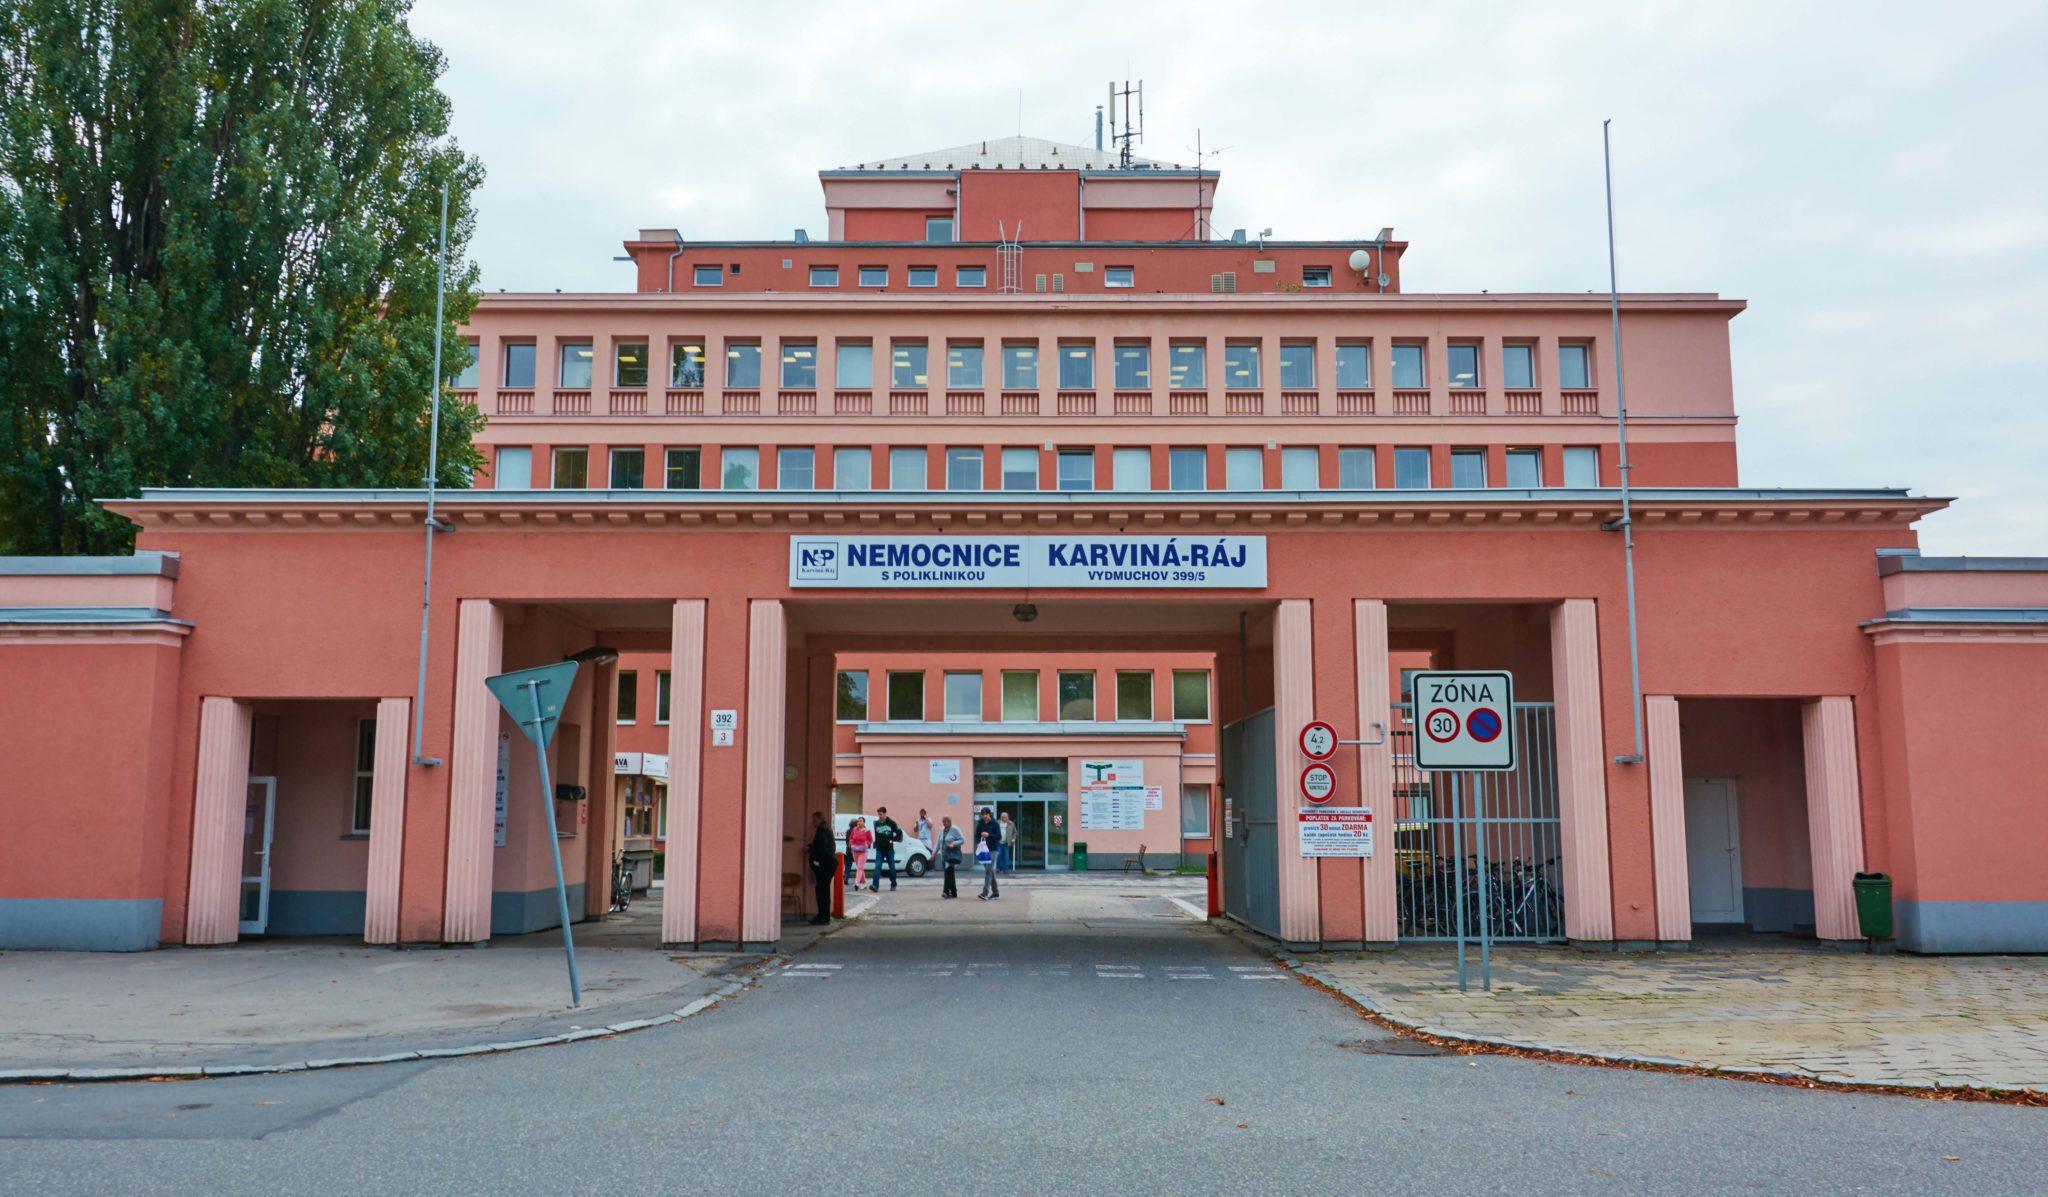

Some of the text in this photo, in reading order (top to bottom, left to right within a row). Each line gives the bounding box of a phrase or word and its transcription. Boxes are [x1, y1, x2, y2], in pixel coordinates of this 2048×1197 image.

[848, 538, 1246, 567] NEMOCNICE KARVINÁ-RÁJ
[882, 571, 985, 581] S POLIKLINIKOU
[1088, 571, 1206, 582] VYDMUCHOV 399/5
[1430, 678, 1494, 703] ZÓNA
[716, 713, 732, 723] 392
[1433, 718, 1452, 733] 30
[720, 732, 726, 741] 3
[1310, 774, 1328, 782] STOP
